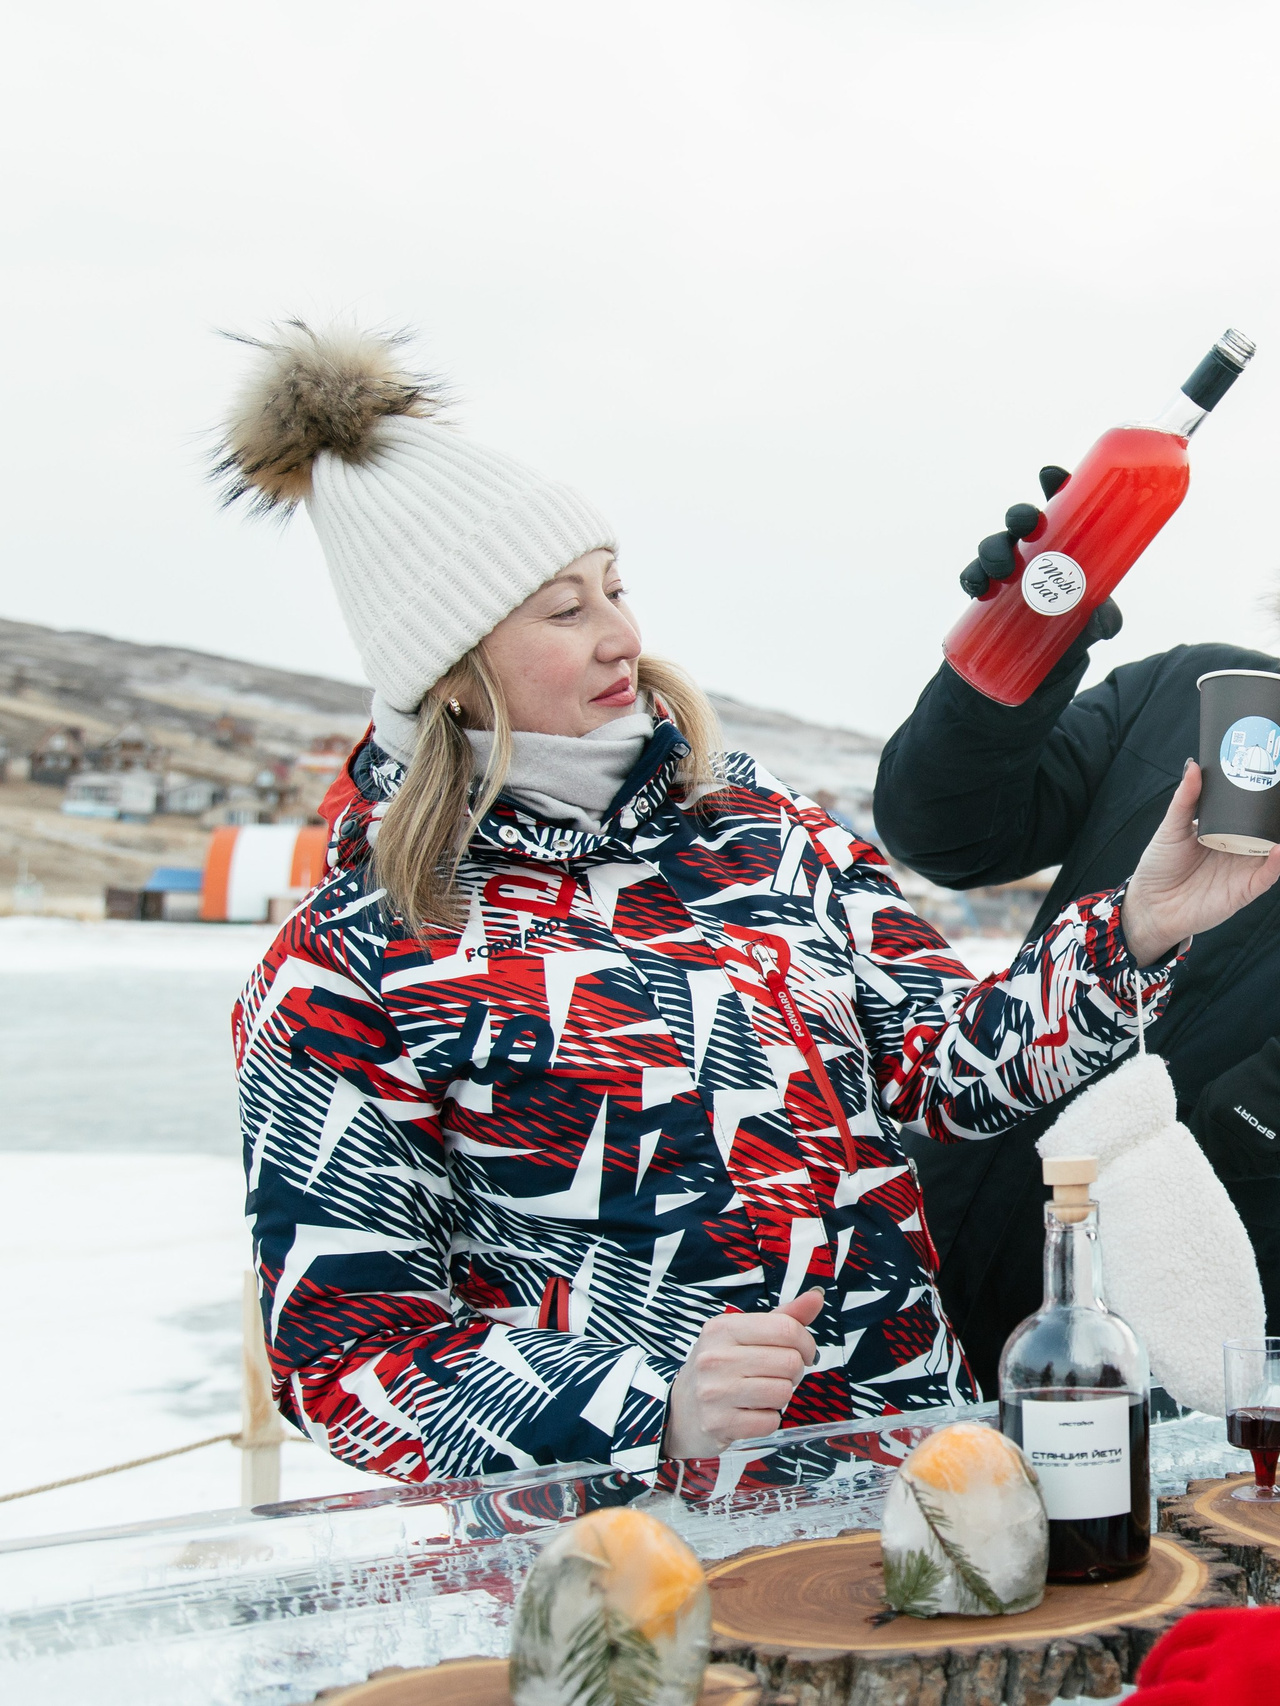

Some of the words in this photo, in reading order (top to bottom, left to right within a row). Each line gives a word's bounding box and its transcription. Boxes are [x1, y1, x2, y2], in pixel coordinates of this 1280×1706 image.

[1031, 580, 1059, 603] bar
[1038, 558, 1081, 595] Mobi
[465, 920, 561, 963] FORWARD
[778, 991, 805, 1038] FORWARD
[1233, 1105, 1276, 1140] SPORT
[1032, 1451, 1088, 1460] СТАНЦИЯ
[1092, 1448, 1122, 1458] ЙЕТИ
